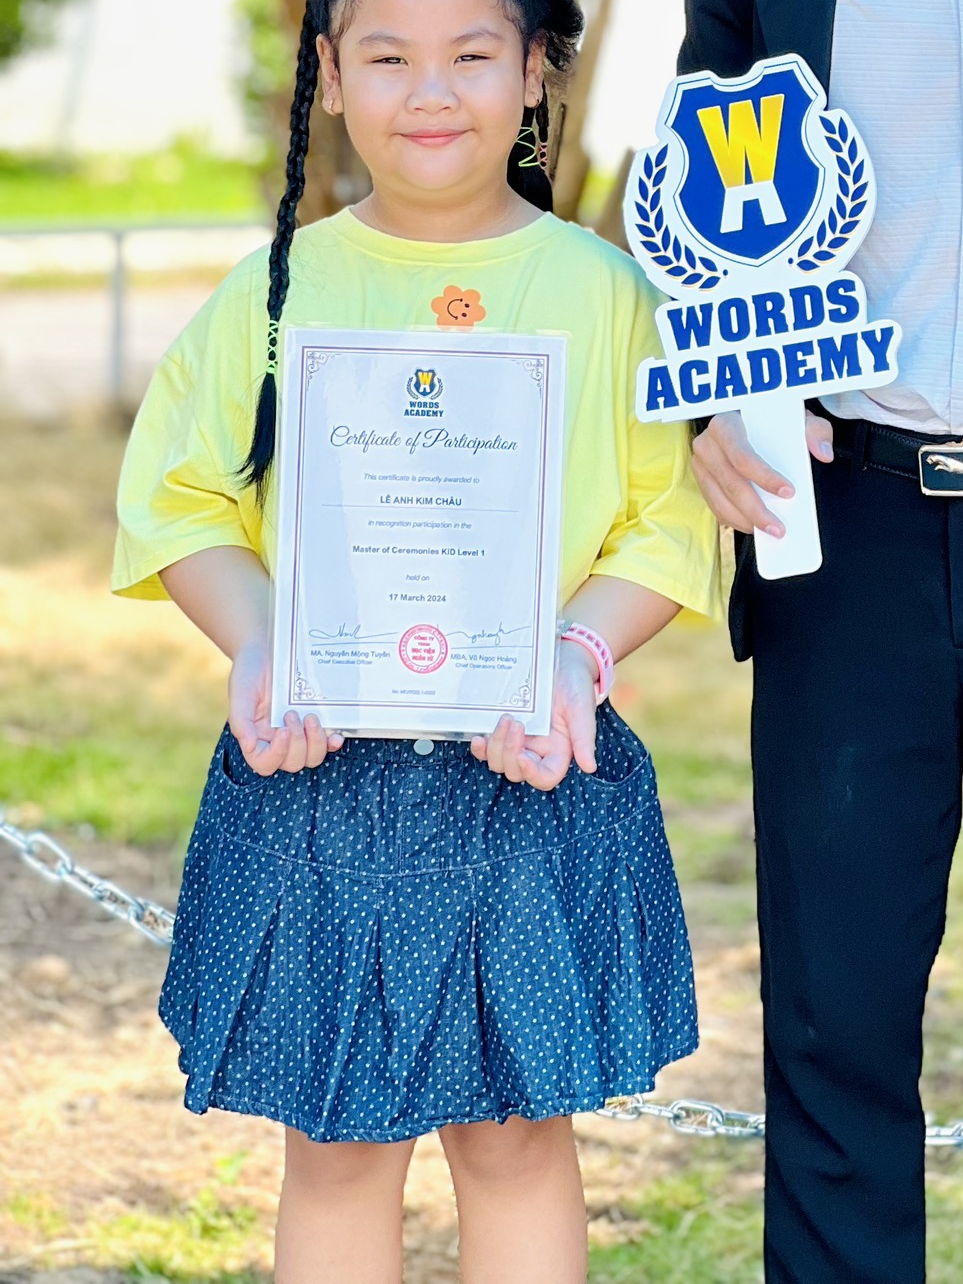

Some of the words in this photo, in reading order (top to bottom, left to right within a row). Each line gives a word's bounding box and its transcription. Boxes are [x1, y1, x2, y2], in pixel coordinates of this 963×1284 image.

[666, 278, 860, 351] WORDS
[645, 325, 895, 412] ACADEMY
[409, 400, 440, 409] WORDS
[403, 409, 444, 417] ACADEMY
[330, 425, 401, 453] Certificate
[405, 431, 421, 455] of
[423, 428, 518, 455] Participation
[364, 473, 377, 481] This
[378, 474, 410, 482] certificate
[411, 474, 417, 482] is
[417, 475, 443, 484] proudly
[443, 476, 472, 484] awarded
[472, 476, 480, 484] to
[380, 494, 392, 504] LÊ
[393, 496, 414, 504] ANH
[415, 496, 433, 505] KIM
[435, 496, 462, 506] CHÂU
[375, 520, 412, 528] recognition
[412, 520, 452, 529] participation
[460, 521, 472, 529] the
[352, 545, 381, 553] Master
[381, 546, 390, 554] of
[391, 546, 440, 555] Ceremonies
[441, 548, 456, 556] KID
[457, 548, 479, 556] Level
[480, 549, 485, 557] 1
[389, 593, 399, 601] 17
[400, 593, 426, 602] March
[426, 594, 447, 603] 2024
